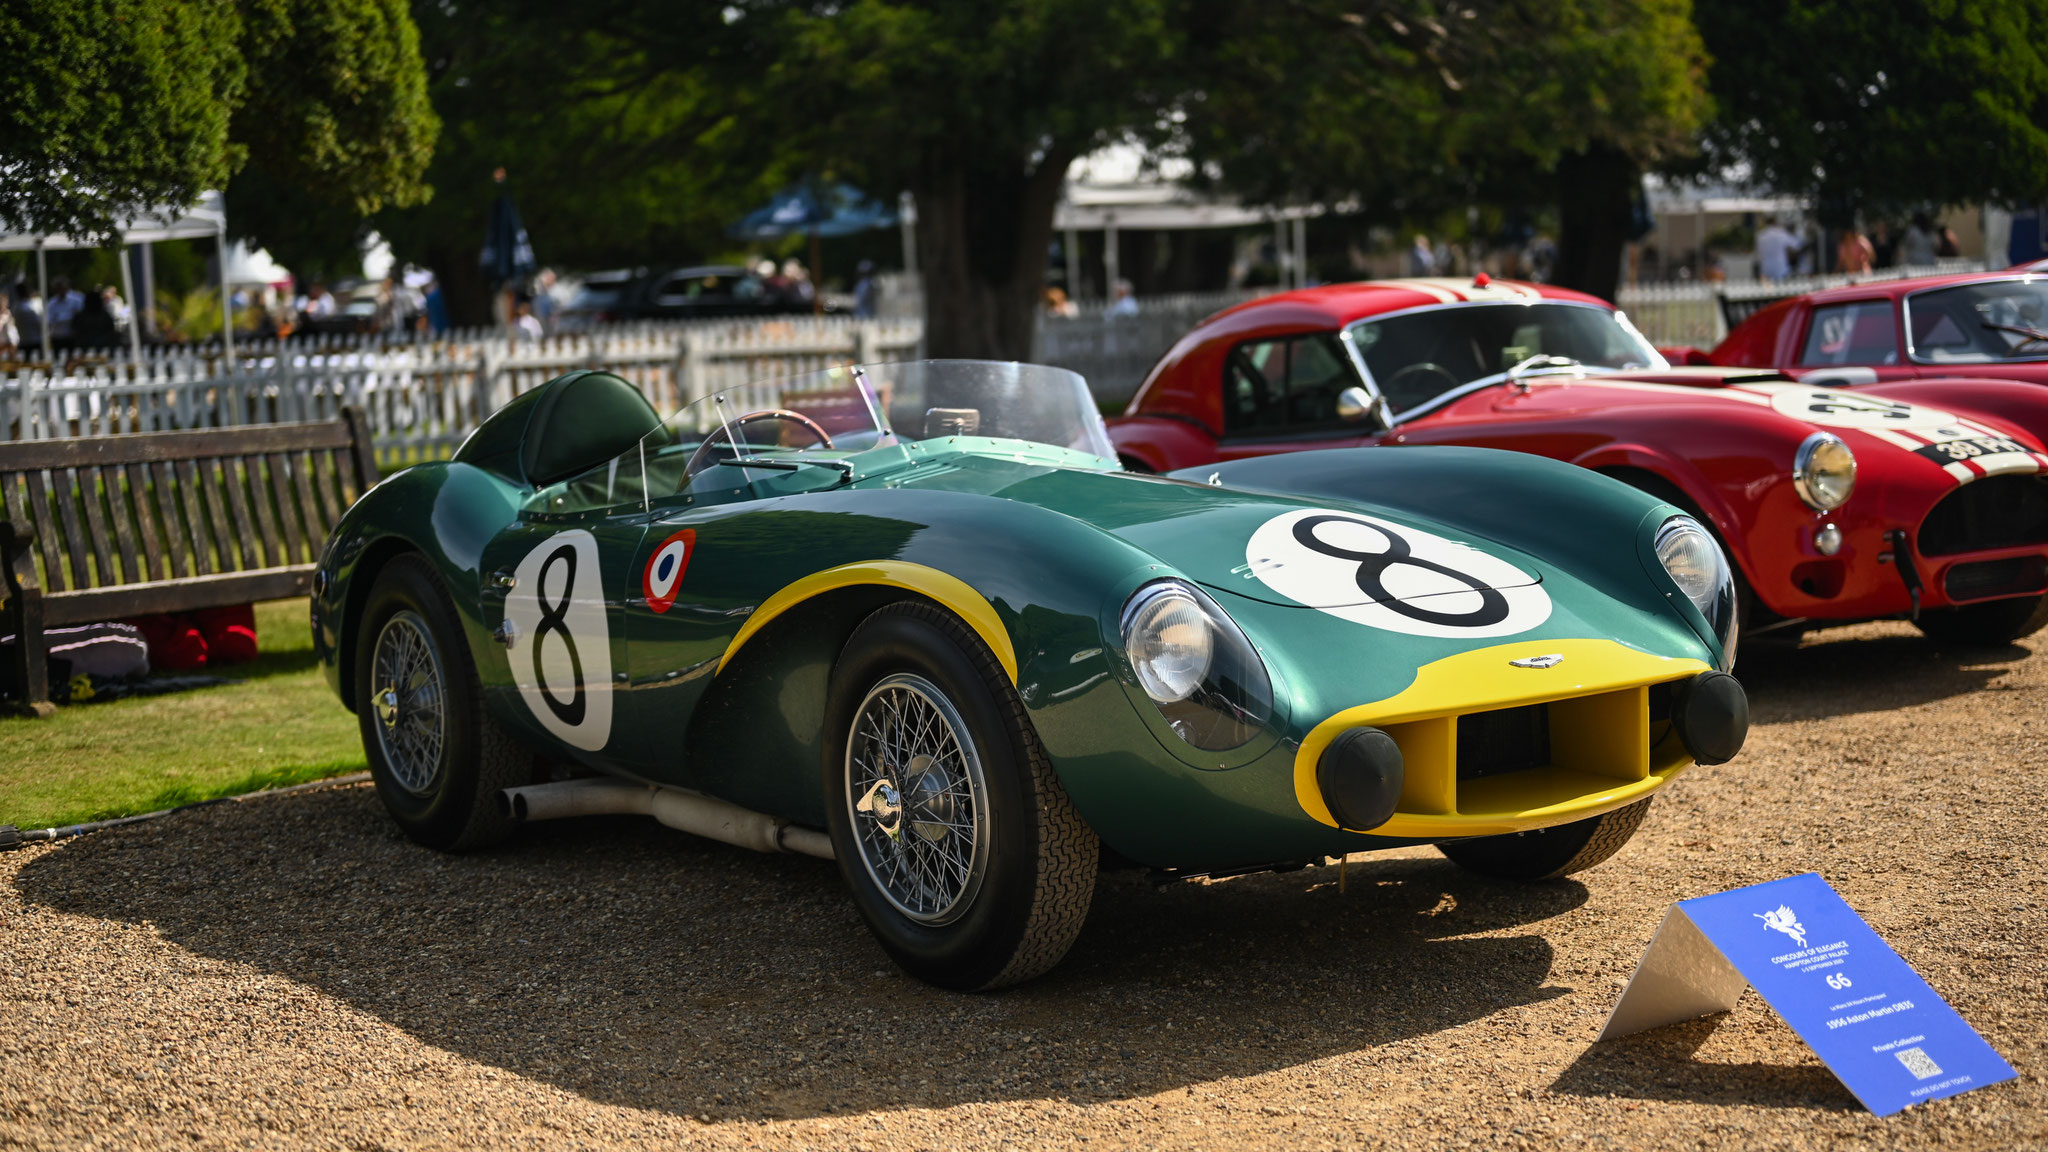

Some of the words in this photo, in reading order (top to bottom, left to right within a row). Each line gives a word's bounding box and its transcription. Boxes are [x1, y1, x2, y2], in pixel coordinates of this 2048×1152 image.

[1936, 440, 1982, 460] 39
[1292, 515, 1510, 627] 8
[533, 545, 586, 732] 8
[1771, 950, 1808, 964] CONCOURS
[1806, 948, 1816, 956] OF
[1815, 941, 1849, 953] ELEGANCE
[1783, 958, 1812, 969] HAMPTON
[1810, 953, 1829, 963] COURT
[1828, 949, 1849, 958] PALACE
[1826, 972, 1852, 990] 66
[1826, 1017, 1848, 1030] 1956
[1846, 1013, 1870, 1024] Aston
[1867, 1007, 1894, 1018] Martin
[1872, 1043, 1895, 1053] Private
[1893, 1035, 1925, 1047] Collection
[1910, 1087, 1931, 1097] PLEASE
[1929, 1084, 1940, 1092] DO
[1938, 1080, 1952, 1089] NOT
[1950, 1075, 1972, 1085] TOUCH
